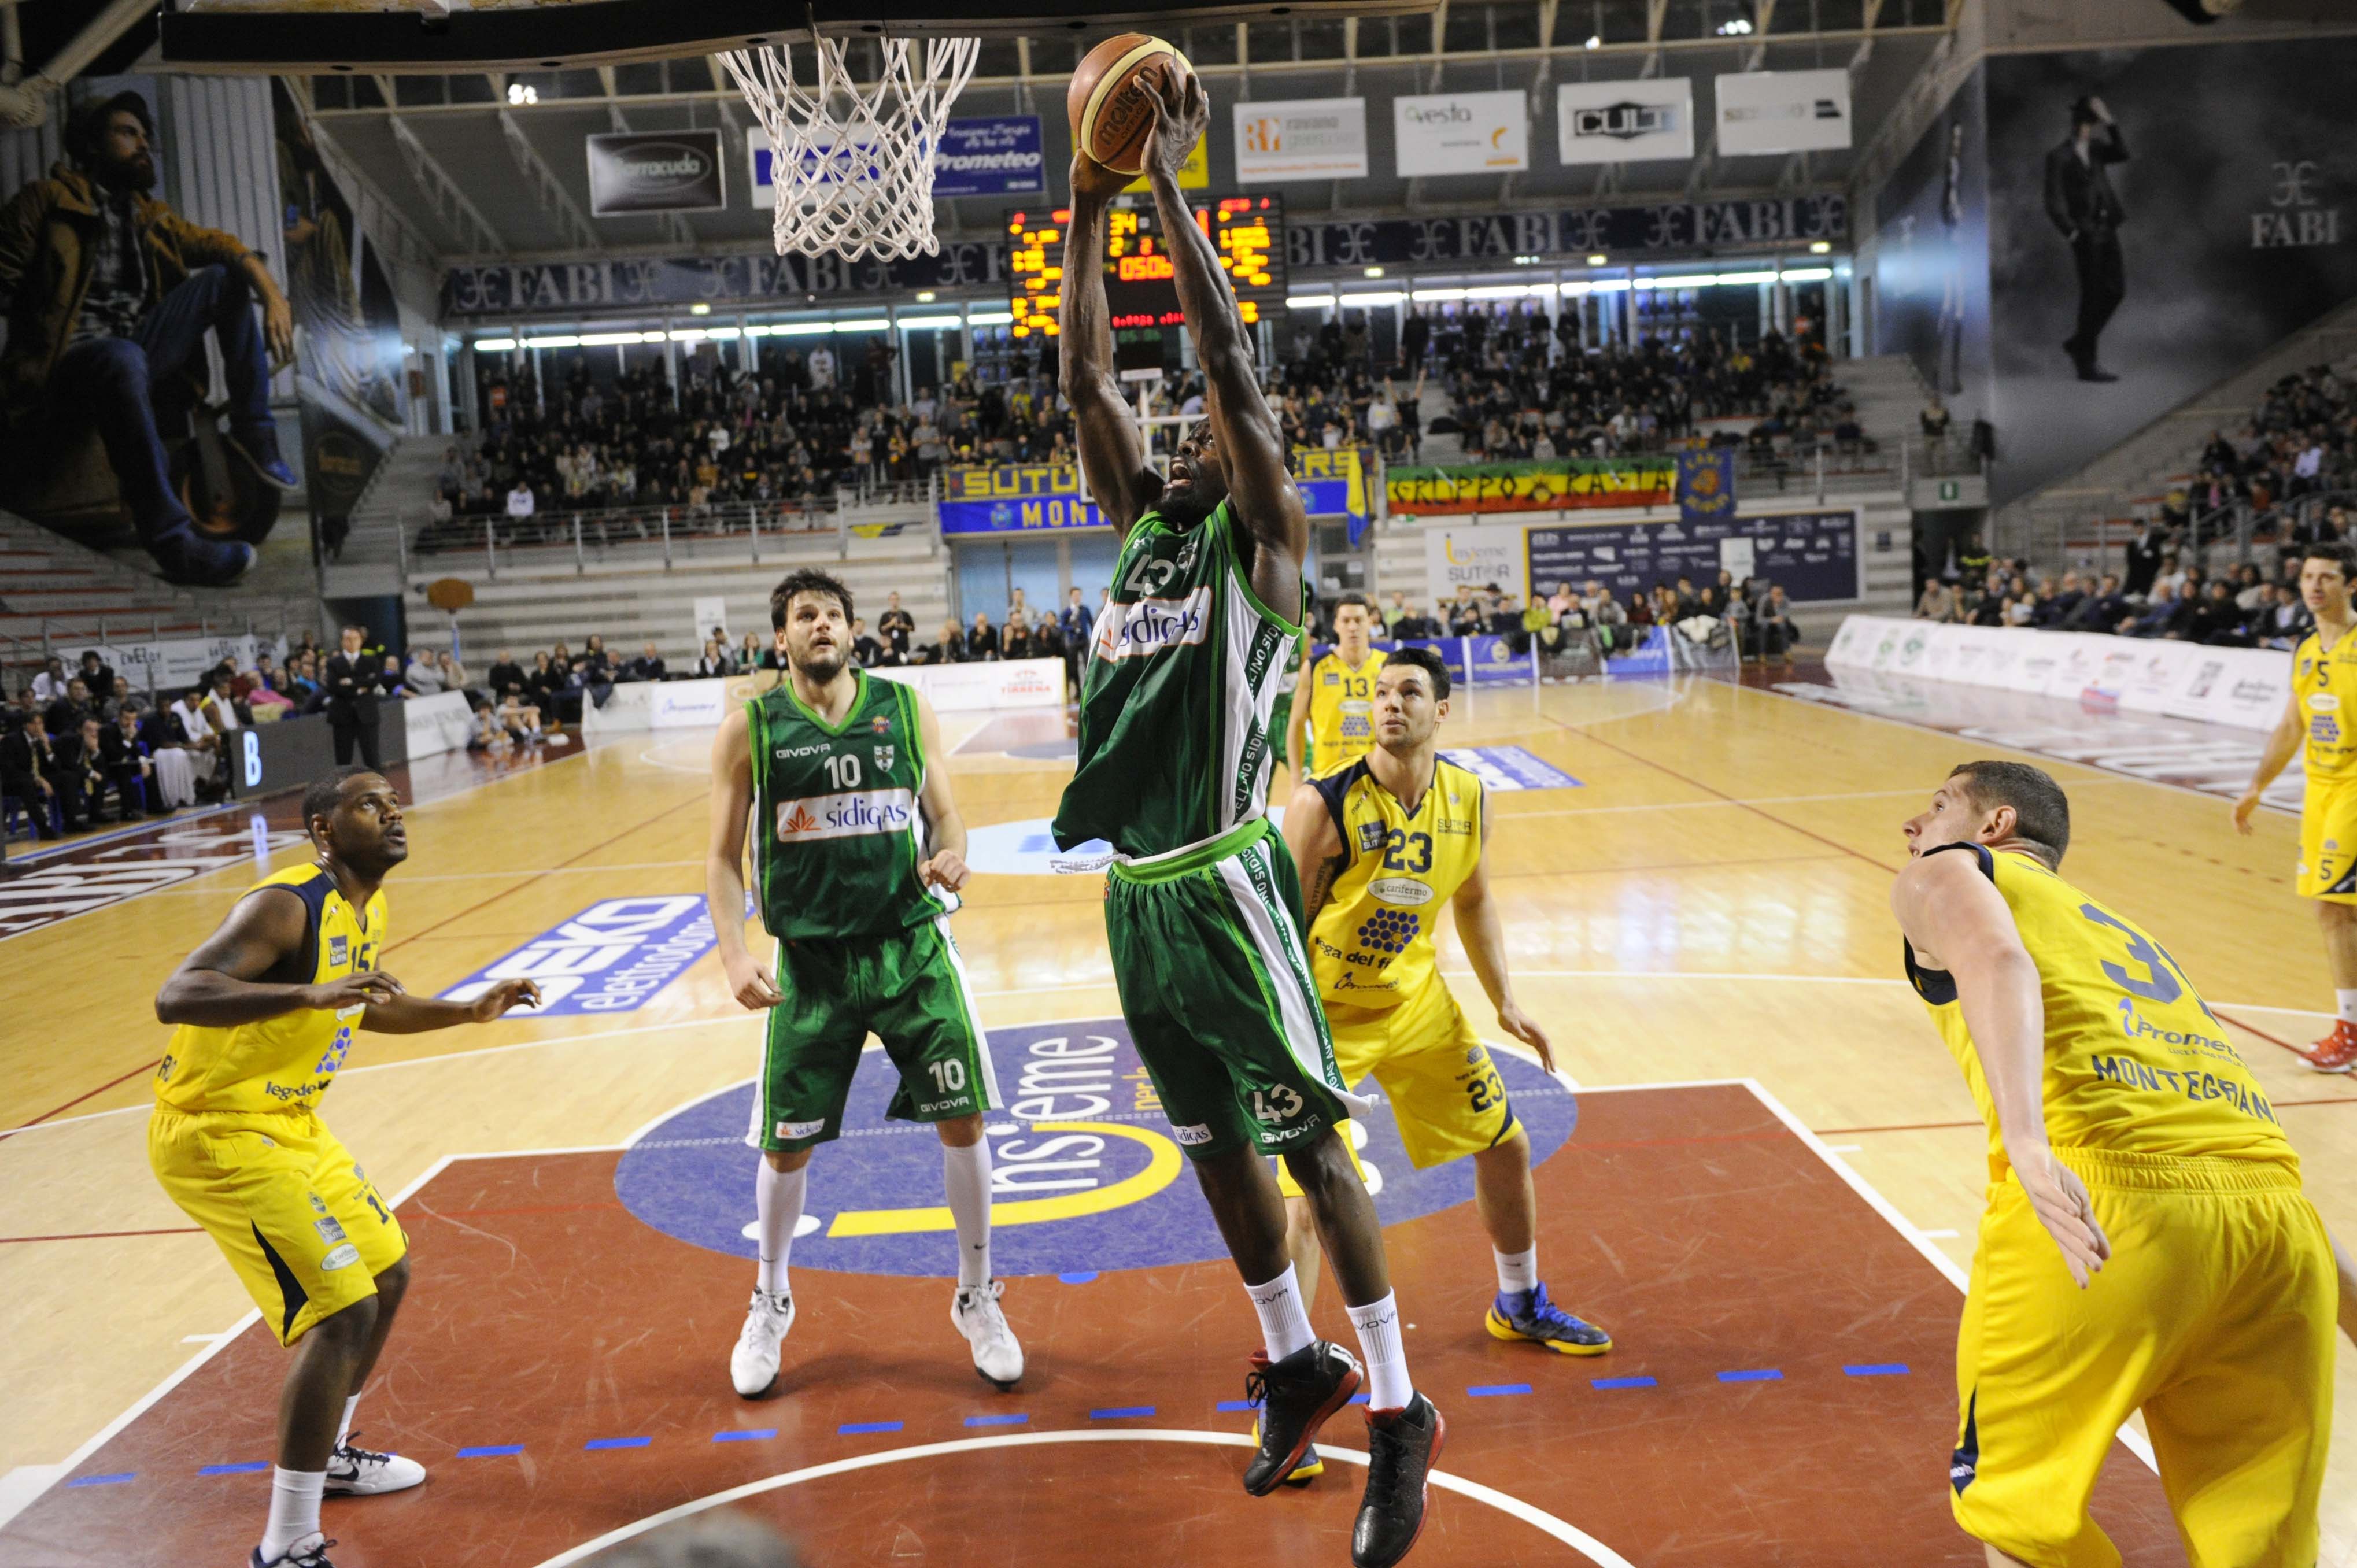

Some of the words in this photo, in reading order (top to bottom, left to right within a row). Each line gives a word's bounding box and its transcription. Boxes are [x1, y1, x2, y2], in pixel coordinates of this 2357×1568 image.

[932, 151, 1041, 171] Prometeo
[1460, 212, 1561, 258] FABI
[1694, 199, 1797, 244] FABI
[2251, 209, 2340, 249] FABI
[1287, 223, 1327, 265] BI
[509, 264, 613, 306] FABI
[752, 253, 854, 295] FABI
[1125, 553, 1175, 597] 43
[1344, 677, 1369, 698] 13
[2317, 660, 2331, 687] 5
[243, 731, 263, 787] B
[775, 743, 831, 759] GIVOVA
[824, 753, 862, 789] 10
[1382, 827, 1432, 874] 23
[2319, 860, 2333, 881] 5
[1386, 883, 1428, 897] carifermo
[352, 942, 371, 972] 15
[1315, 937, 1342, 959] lega
[1346, 952, 1375, 967] del
[2078, 903, 2189, 1005] 3
[2138, 1018, 2240, 1059] Promet
[928, 1057, 965, 1094] 10
[1466, 1072, 1504, 1114] 23
[2092, 1055, 2281, 1126] MONTEGRAN
[920, 1096, 970, 1112] GIVOVA
[1253, 1083, 1303, 1123] 43
[367, 1193, 390, 1225] 1
